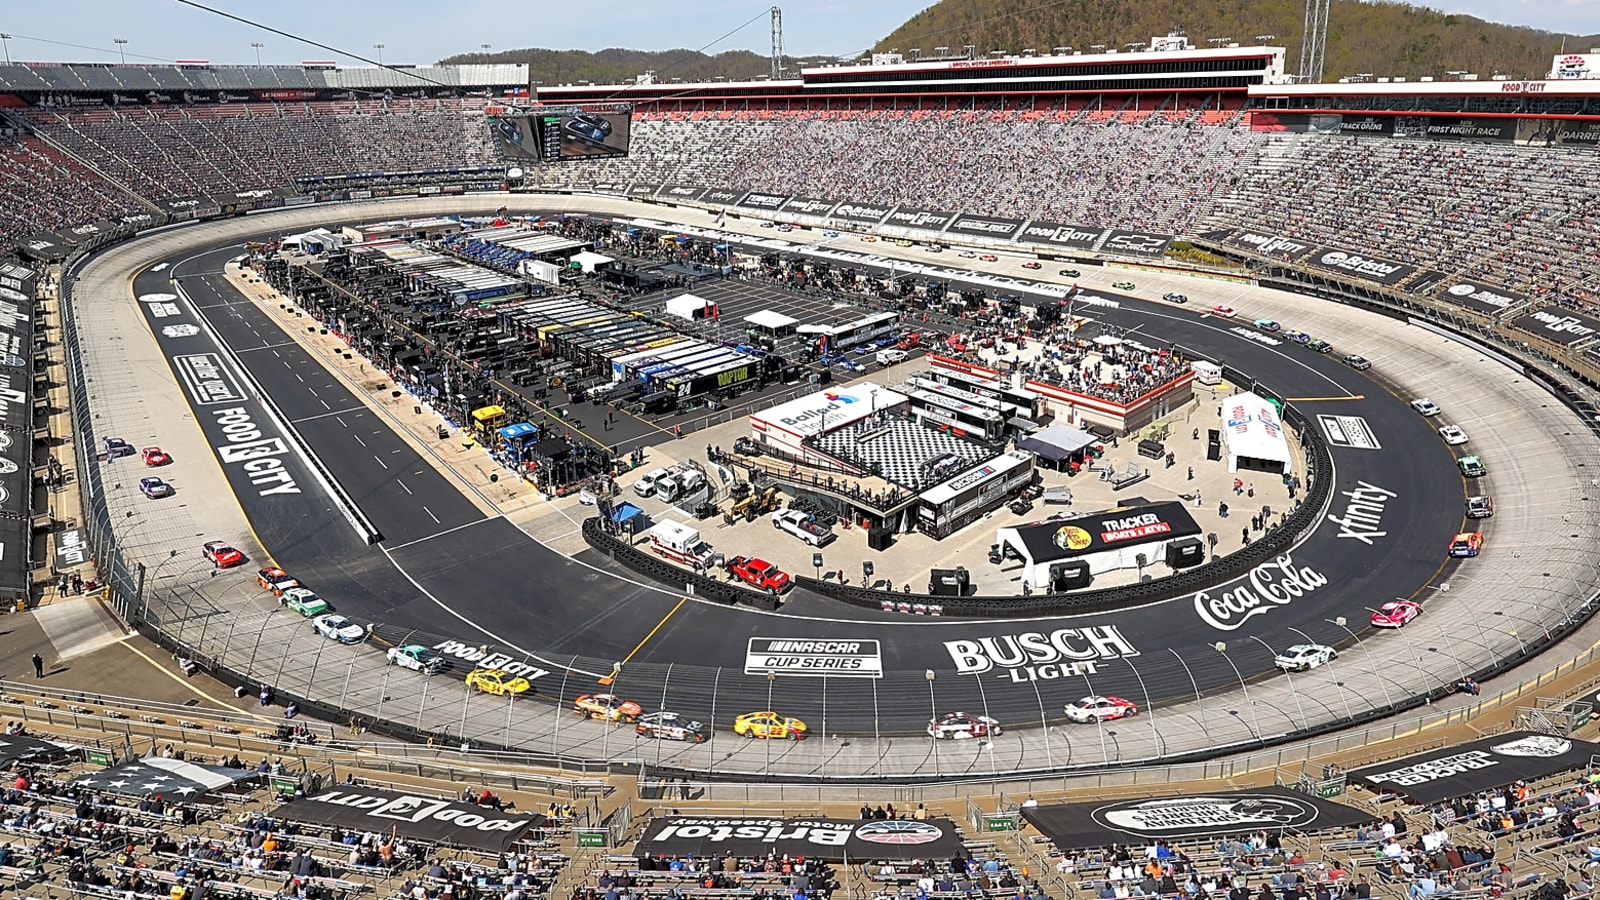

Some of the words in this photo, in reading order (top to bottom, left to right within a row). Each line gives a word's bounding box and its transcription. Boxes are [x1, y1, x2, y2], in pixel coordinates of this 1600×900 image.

[1501, 83, 1521, 91] FOOD
[1529, 83, 1546, 91] CITY
[1340, 122, 1360, 130] TRACK
[1360, 122, 1382, 131] OPENS
[1427, 125, 1449, 134] FIRST
[1450, 126, 1476, 135] NIGHT
[1476, 127, 1501, 136] RACE
[787, 200, 807, 208] FOOD
[813, 203, 833, 211] CITY
[891, 212, 916, 220] FOOD
[925, 216, 949, 225] CITY
[1024, 227, 1056, 237] FOOD
[1070, 231, 1098, 242] CITY
[1106, 242, 1162, 254] CHEVROLET
[1238, 233, 1268, 245] FOOD
[1277, 240, 1307, 253] CITY
[1343, 255, 1402, 275] Bristol
[1530, 310, 1561, 323] FOOD
[1566, 324, 1596, 336] CITY
[717, 367, 748, 387] RAPTOR
[677, 382, 692, 397] 24
[780, 402, 841, 426] Ballad
[794, 412, 849, 433] Health
[212, 407, 262, 443] FOOD
[243, 458, 302, 497] CITY
[1328, 480, 1398, 545] xfinity
[1101, 512, 1161, 532] TRACKER
[1064, 526, 1080, 535] Bass
[1067, 534, 1081, 542] Pro
[1106, 528, 1137, 542] BOATS
[1144, 523, 1168, 537] ATVs
[1070, 538, 1089, 549] Shops
[788, 641, 861, 654] NASCAR
[943, 624, 1141, 676] BUSCH
[432, 639, 488, 662] FOOD
[501, 661, 551, 680] CITY
[764, 656, 800, 668] CUP
[801, 658, 863, 669] SERIES
[1009, 660, 1098, 683] LIGHT
[492, 683, 501, 692] 34
[770, 727, 783, 736] 22
[1427, 752, 1481, 768] BOATS
[1390, 757, 1500, 786] TRACKER
[1332, 786, 1338, 794] X
[306, 791, 388, 808] CITY
[1131, 809, 1229, 822] CHILDREN'S
[1136, 805, 1220, 816] CHARITIES
[432, 809, 529, 831] FOOD
[668, 820, 784, 828] Speedway
[789, 821, 855, 831] Motor
[1143, 814, 1240, 828] SPEEDWAY
[652, 825, 855, 846] Bristol
